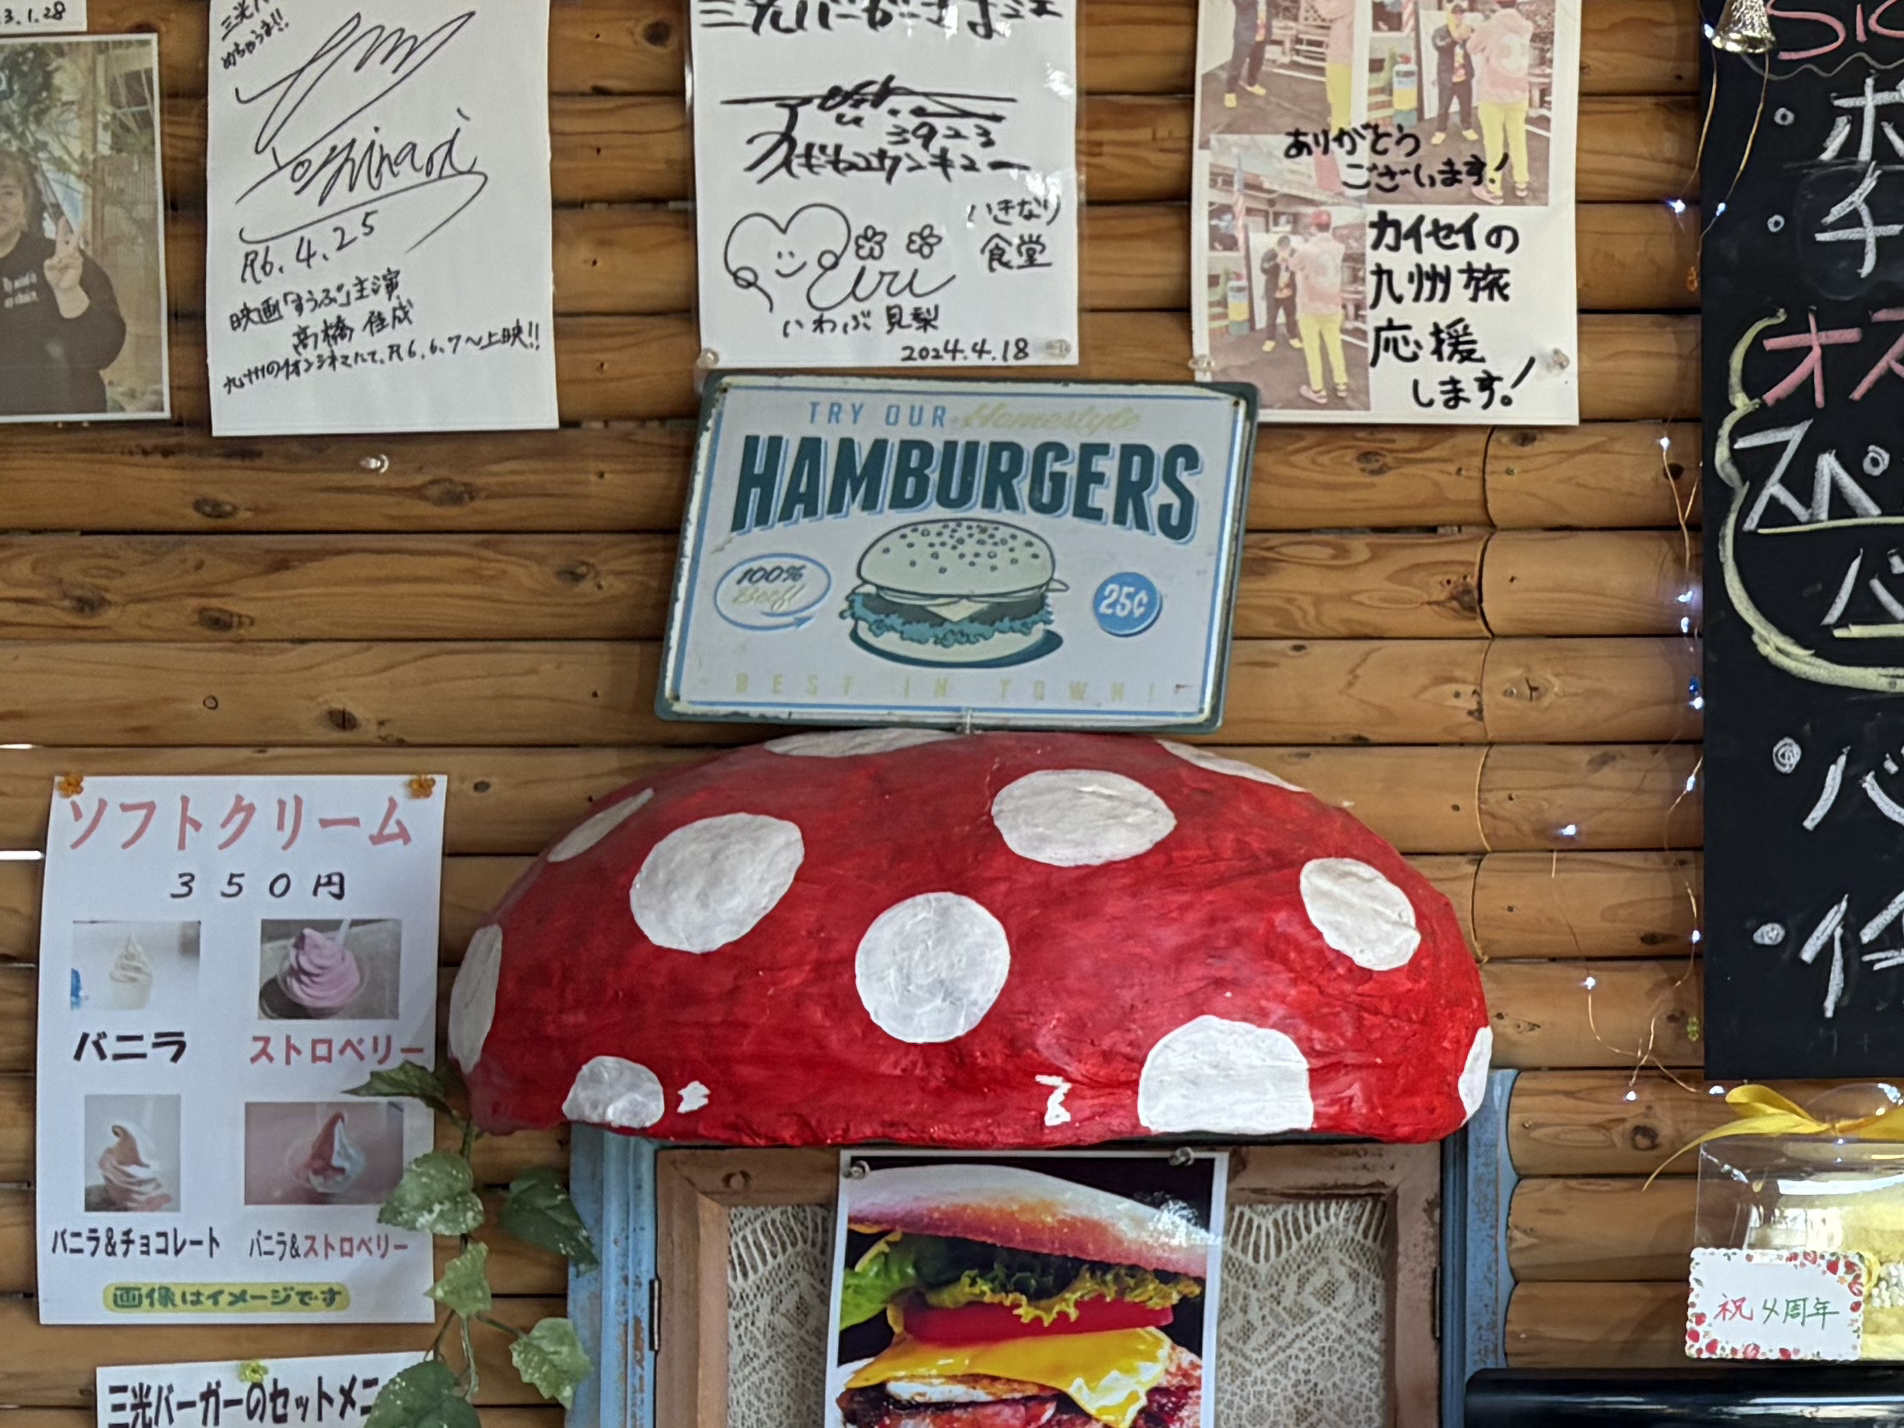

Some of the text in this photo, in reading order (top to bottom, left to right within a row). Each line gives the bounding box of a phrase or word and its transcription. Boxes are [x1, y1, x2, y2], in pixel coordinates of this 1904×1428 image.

[1283, 123, 1420, 159] ありがとう
[969, 195, 1062, 225] いきなり
[1368, 211, 1519, 254] カイセイの
[981, 232, 1052, 272] 食堂
[1368, 262, 1510, 310] 九州旅
[900, 339, 1030, 362] 2024.4.18
[1369, 317, 1486, 368] 応援
[809, 401, 1142, 435] TRY OUR Homestyle
[731, 434, 1204, 544] HAMBURGERS
[736, 565, 804, 585] 100%
[735, 674, 1155, 704] BEST IN TOWN!
[69, 793, 412, 852] ソフトクリーム
[169, 871, 346, 901] 350円
[73, 1031, 425, 1065] バニラ ストロベリー
[51, 1226, 409, 1261] バニラ&チョコレート バニラ&ストロベリー
[112, 1284, 344, 1311] 画像はイメージです
